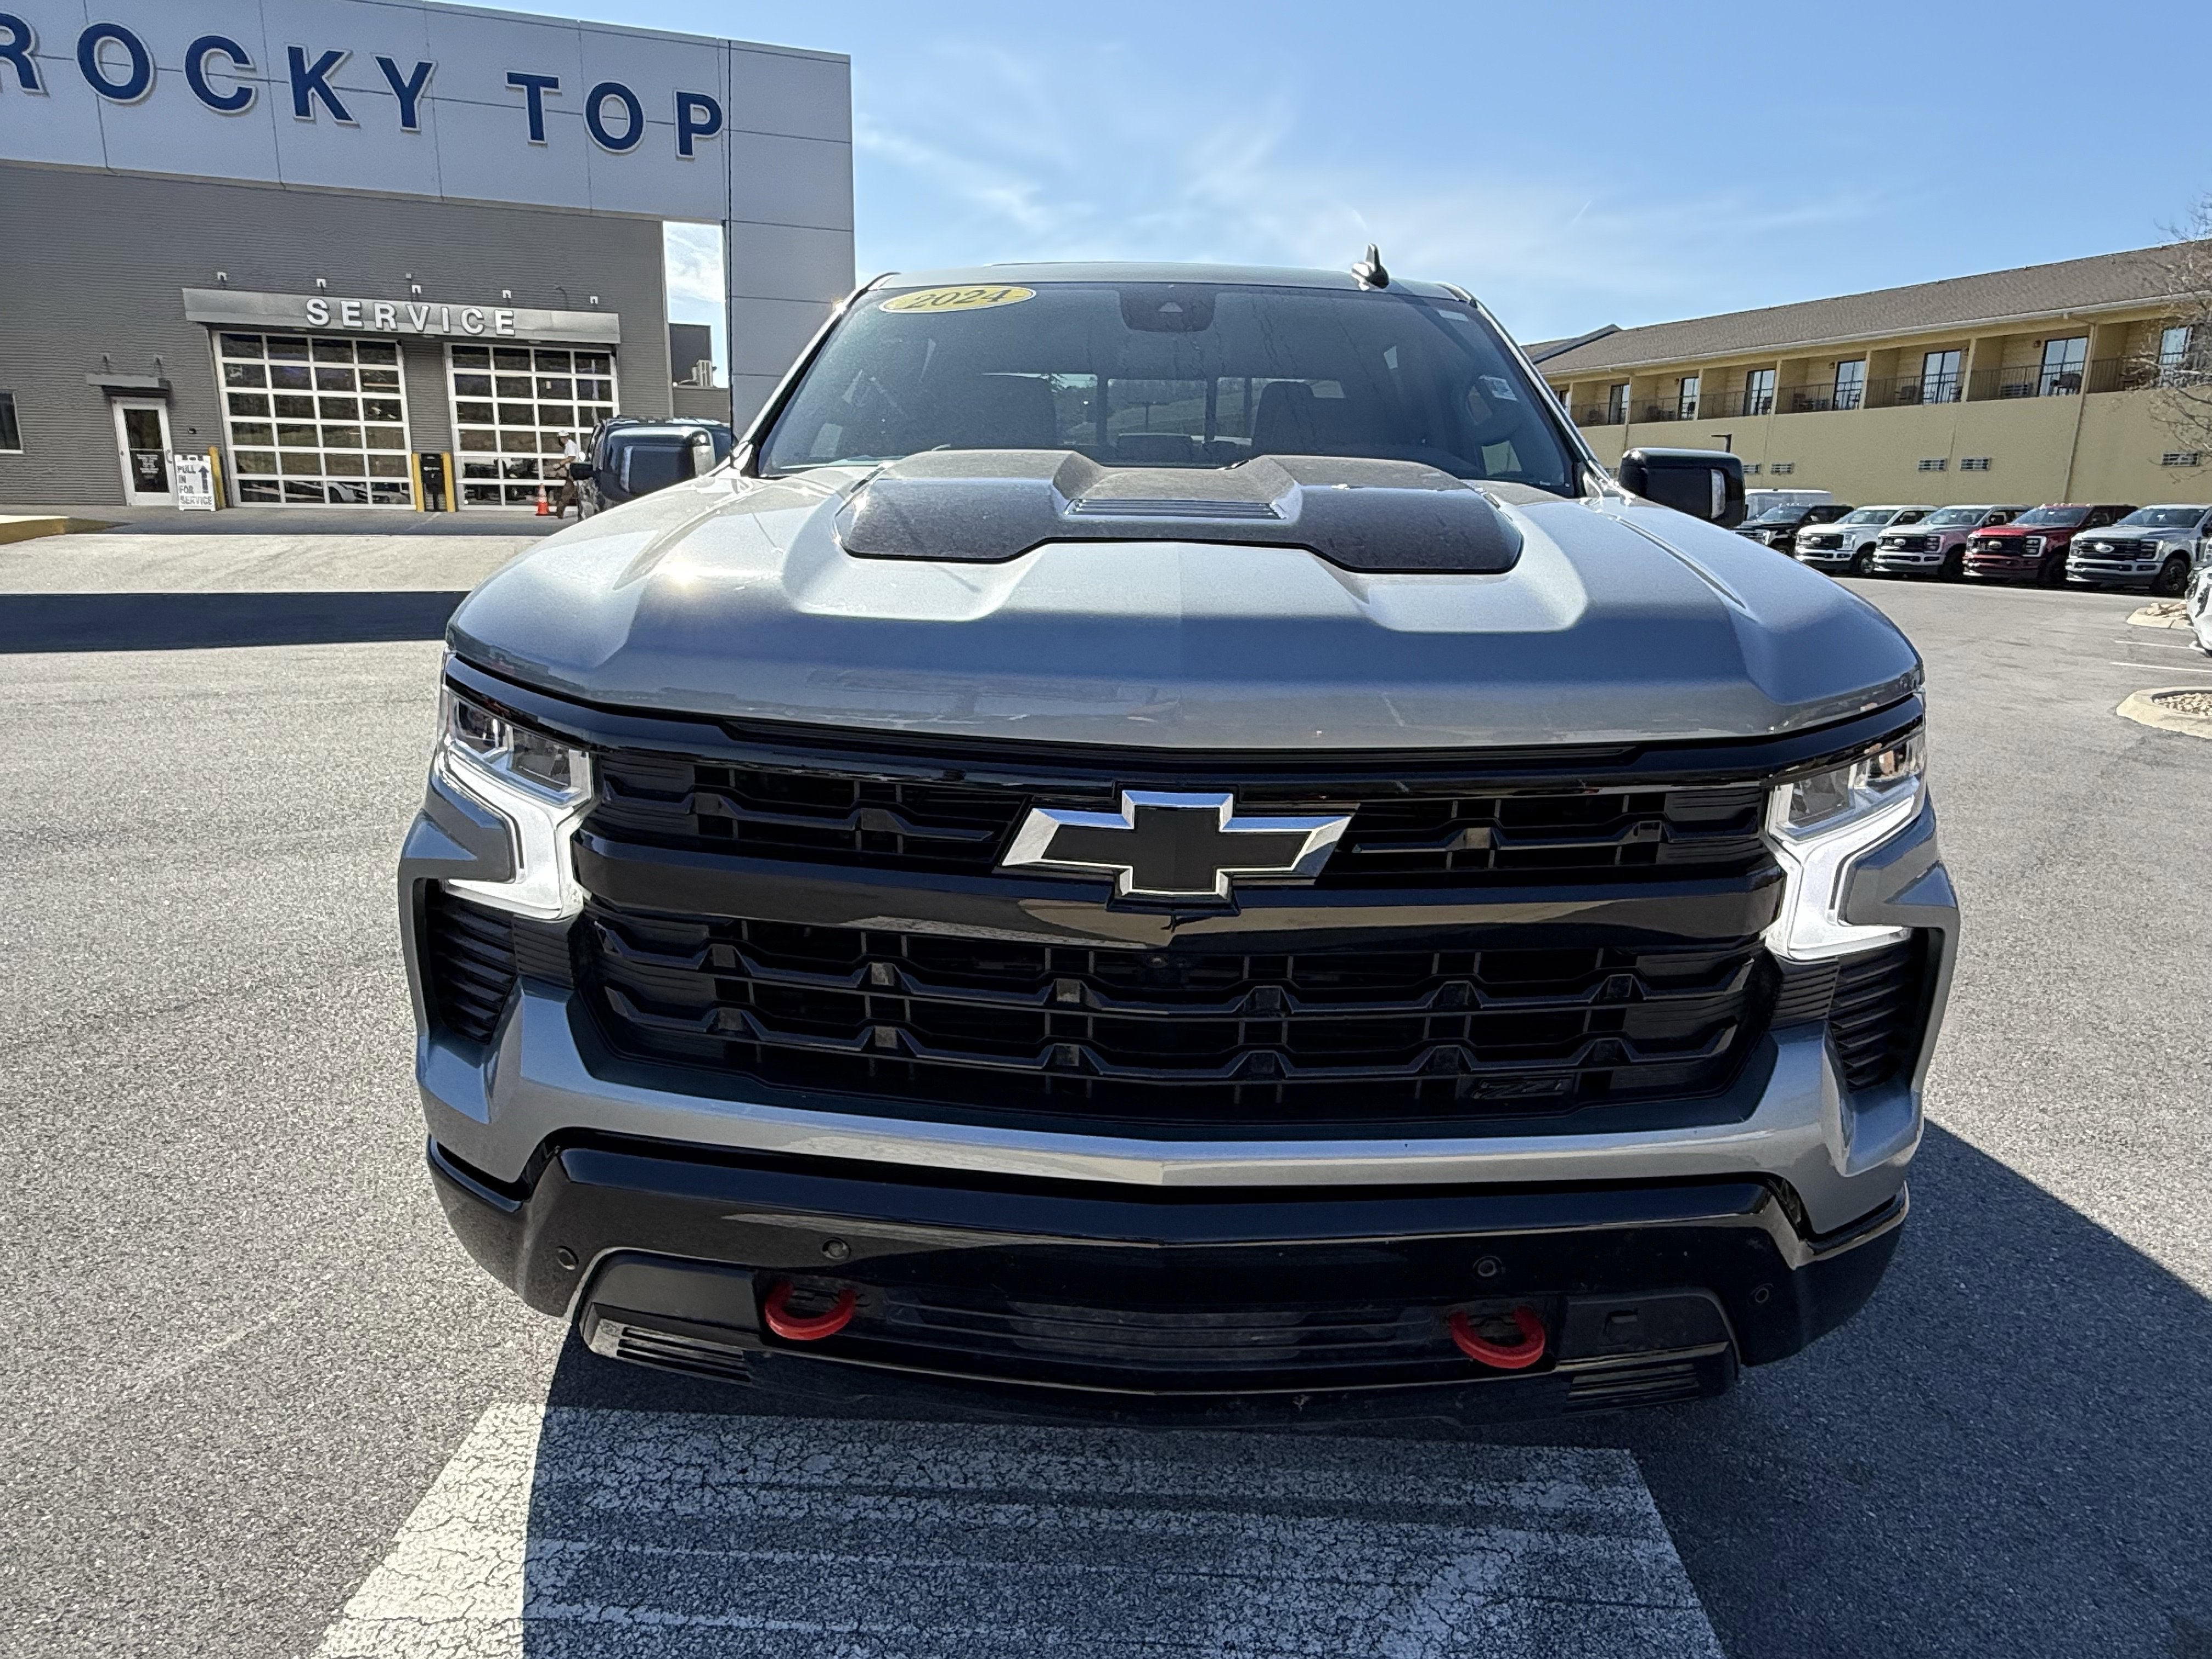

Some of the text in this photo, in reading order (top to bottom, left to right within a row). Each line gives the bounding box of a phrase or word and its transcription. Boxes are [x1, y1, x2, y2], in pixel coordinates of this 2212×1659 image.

[0, 12, 724, 159] ROCKY TOP
[901, 289, 1012, 309] 2024
[306, 298, 516, 336] SERVICE
[177, 465, 196, 473] PULL
[179, 475, 186, 483] IN
[179, 485, 194, 494] FOR
[180, 495, 212, 504] SERVICE
